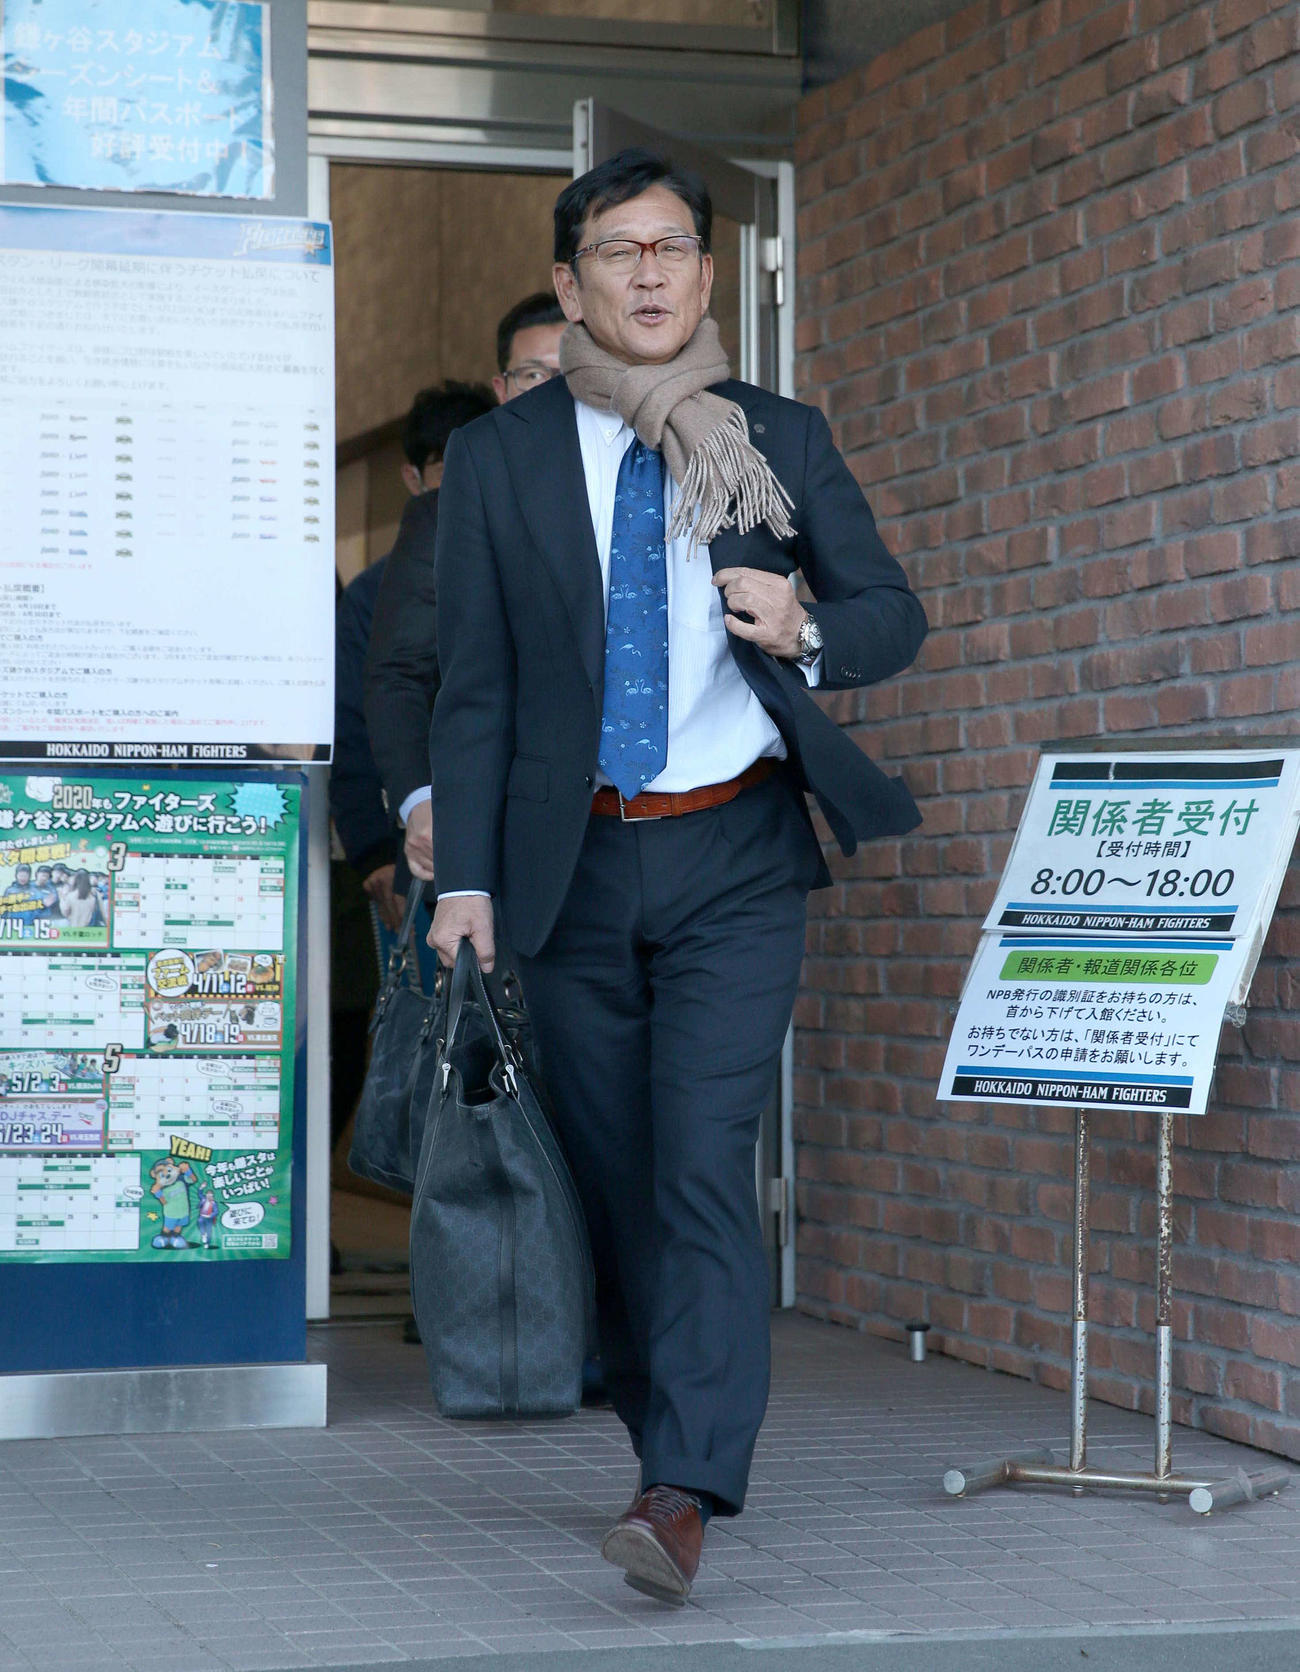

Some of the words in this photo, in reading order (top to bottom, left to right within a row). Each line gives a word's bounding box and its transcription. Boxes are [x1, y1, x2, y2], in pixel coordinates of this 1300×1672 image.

[46, 743, 109, 757] HOKKAIDO
[114, 743, 188, 758] NIPPON-HAM
[192, 745, 247, 758] FIGHTERS
[1047, 798, 1259, 837] 関係者受付
[108, 842, 127, 872] 3
[1096, 840, 1192, 858] 【受付時間】
[1021, 913, 1080, 926] HOKKAIDO
[1082, 915, 1155, 929] NIPPON-HAM
[1157, 917, 1211, 929] FIGHTERS
[1016, 957, 1199, 977] 関係者・報道関係各位
[986, 988, 1198, 1006] NPB発行の識別証をお持ちの方は、
[1006, 1005, 1167, 1024] 首から下げて入館ください。
[967, 1026, 1200, 1047] お持ちでない方は、「関係者受付」にて
[102, 1043, 123, 1073] 5
[967, 1044, 1188, 1067] ワンデーパスの申請をお願いします。
[974, 1080, 1032, 1094] HOKKAIDO
[1037, 1084, 1109, 1100] NIPPON-HAM
[1111, 1088, 1167, 1102] FIGHTERS
[171, 1135, 212, 1162] YEAH!
